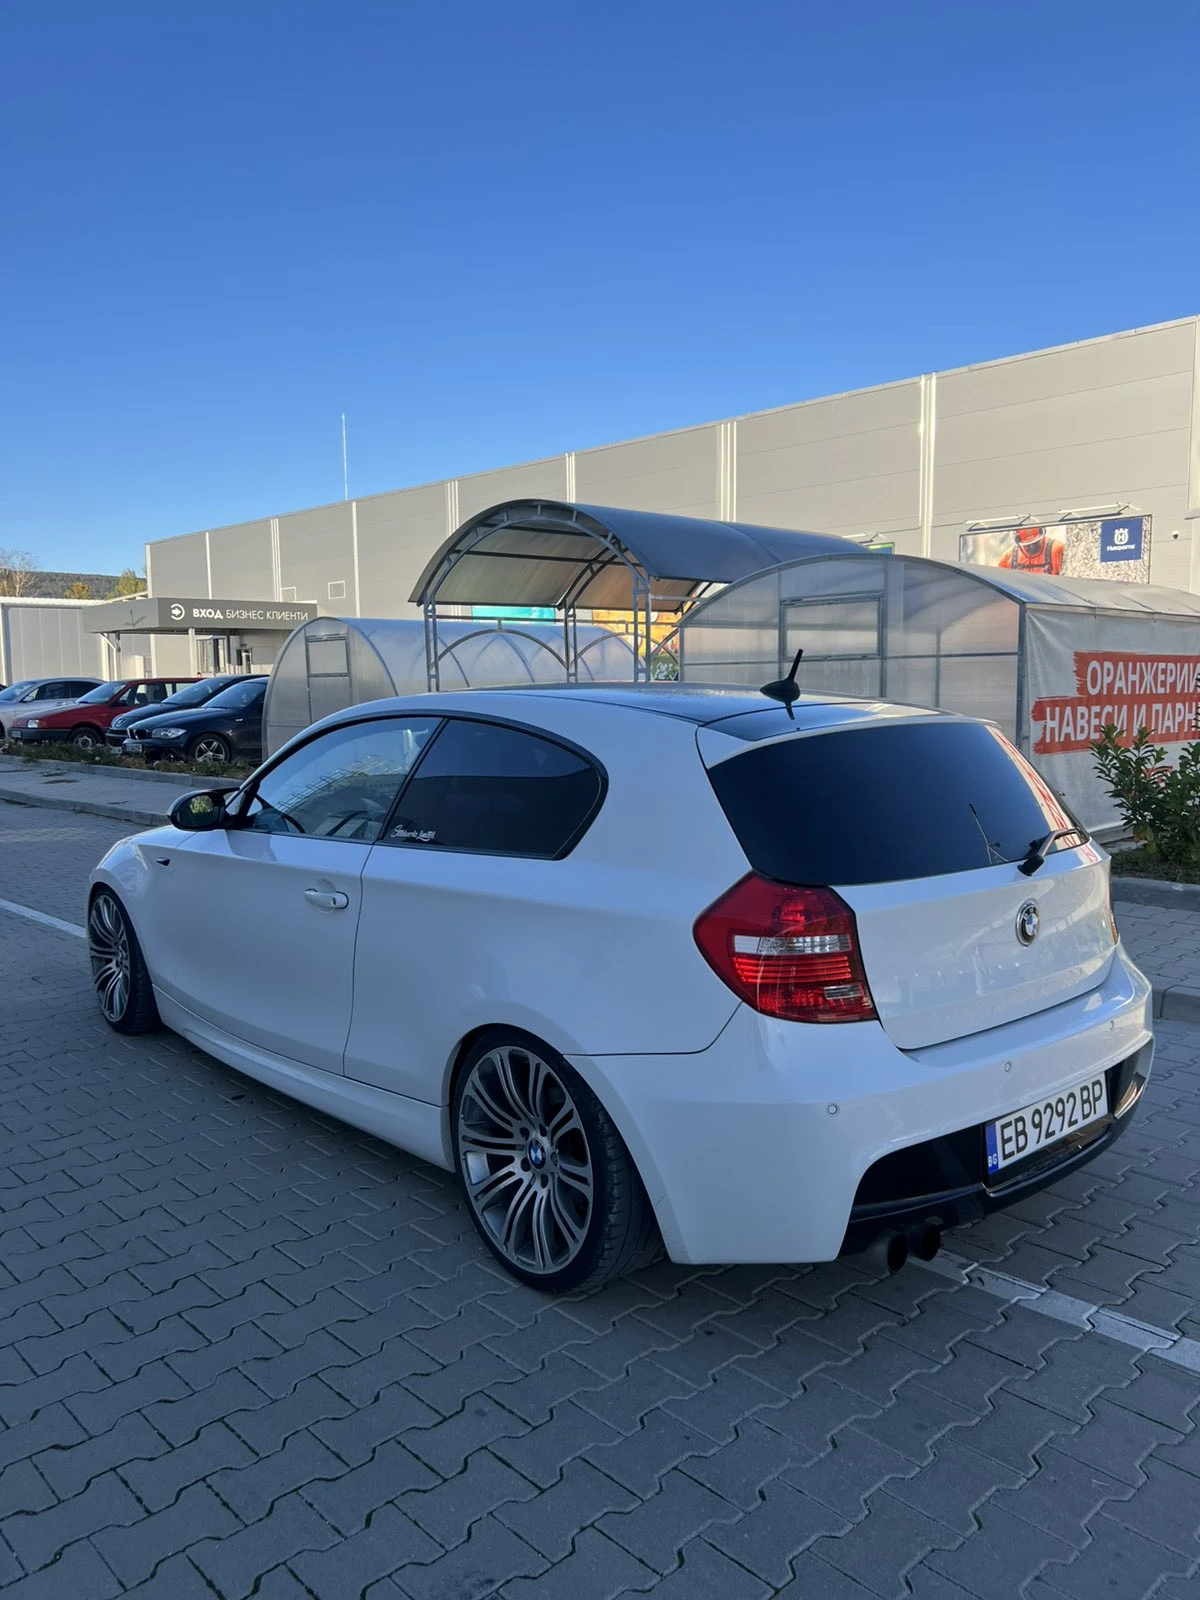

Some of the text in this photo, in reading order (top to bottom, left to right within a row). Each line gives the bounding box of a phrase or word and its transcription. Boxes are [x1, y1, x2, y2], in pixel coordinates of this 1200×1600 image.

[192, 608, 309, 621] ВХОД БИЗНЕС КЛИЕНТИ
[1086, 660, 1200, 696] ОРАНЖЕРИИ
[1045, 701, 1200, 743] НАВЕСИ И ПАРН
[1000, 1079, 1103, 1161] EB 9292 BP
[987, 1153, 998, 1168] BG
